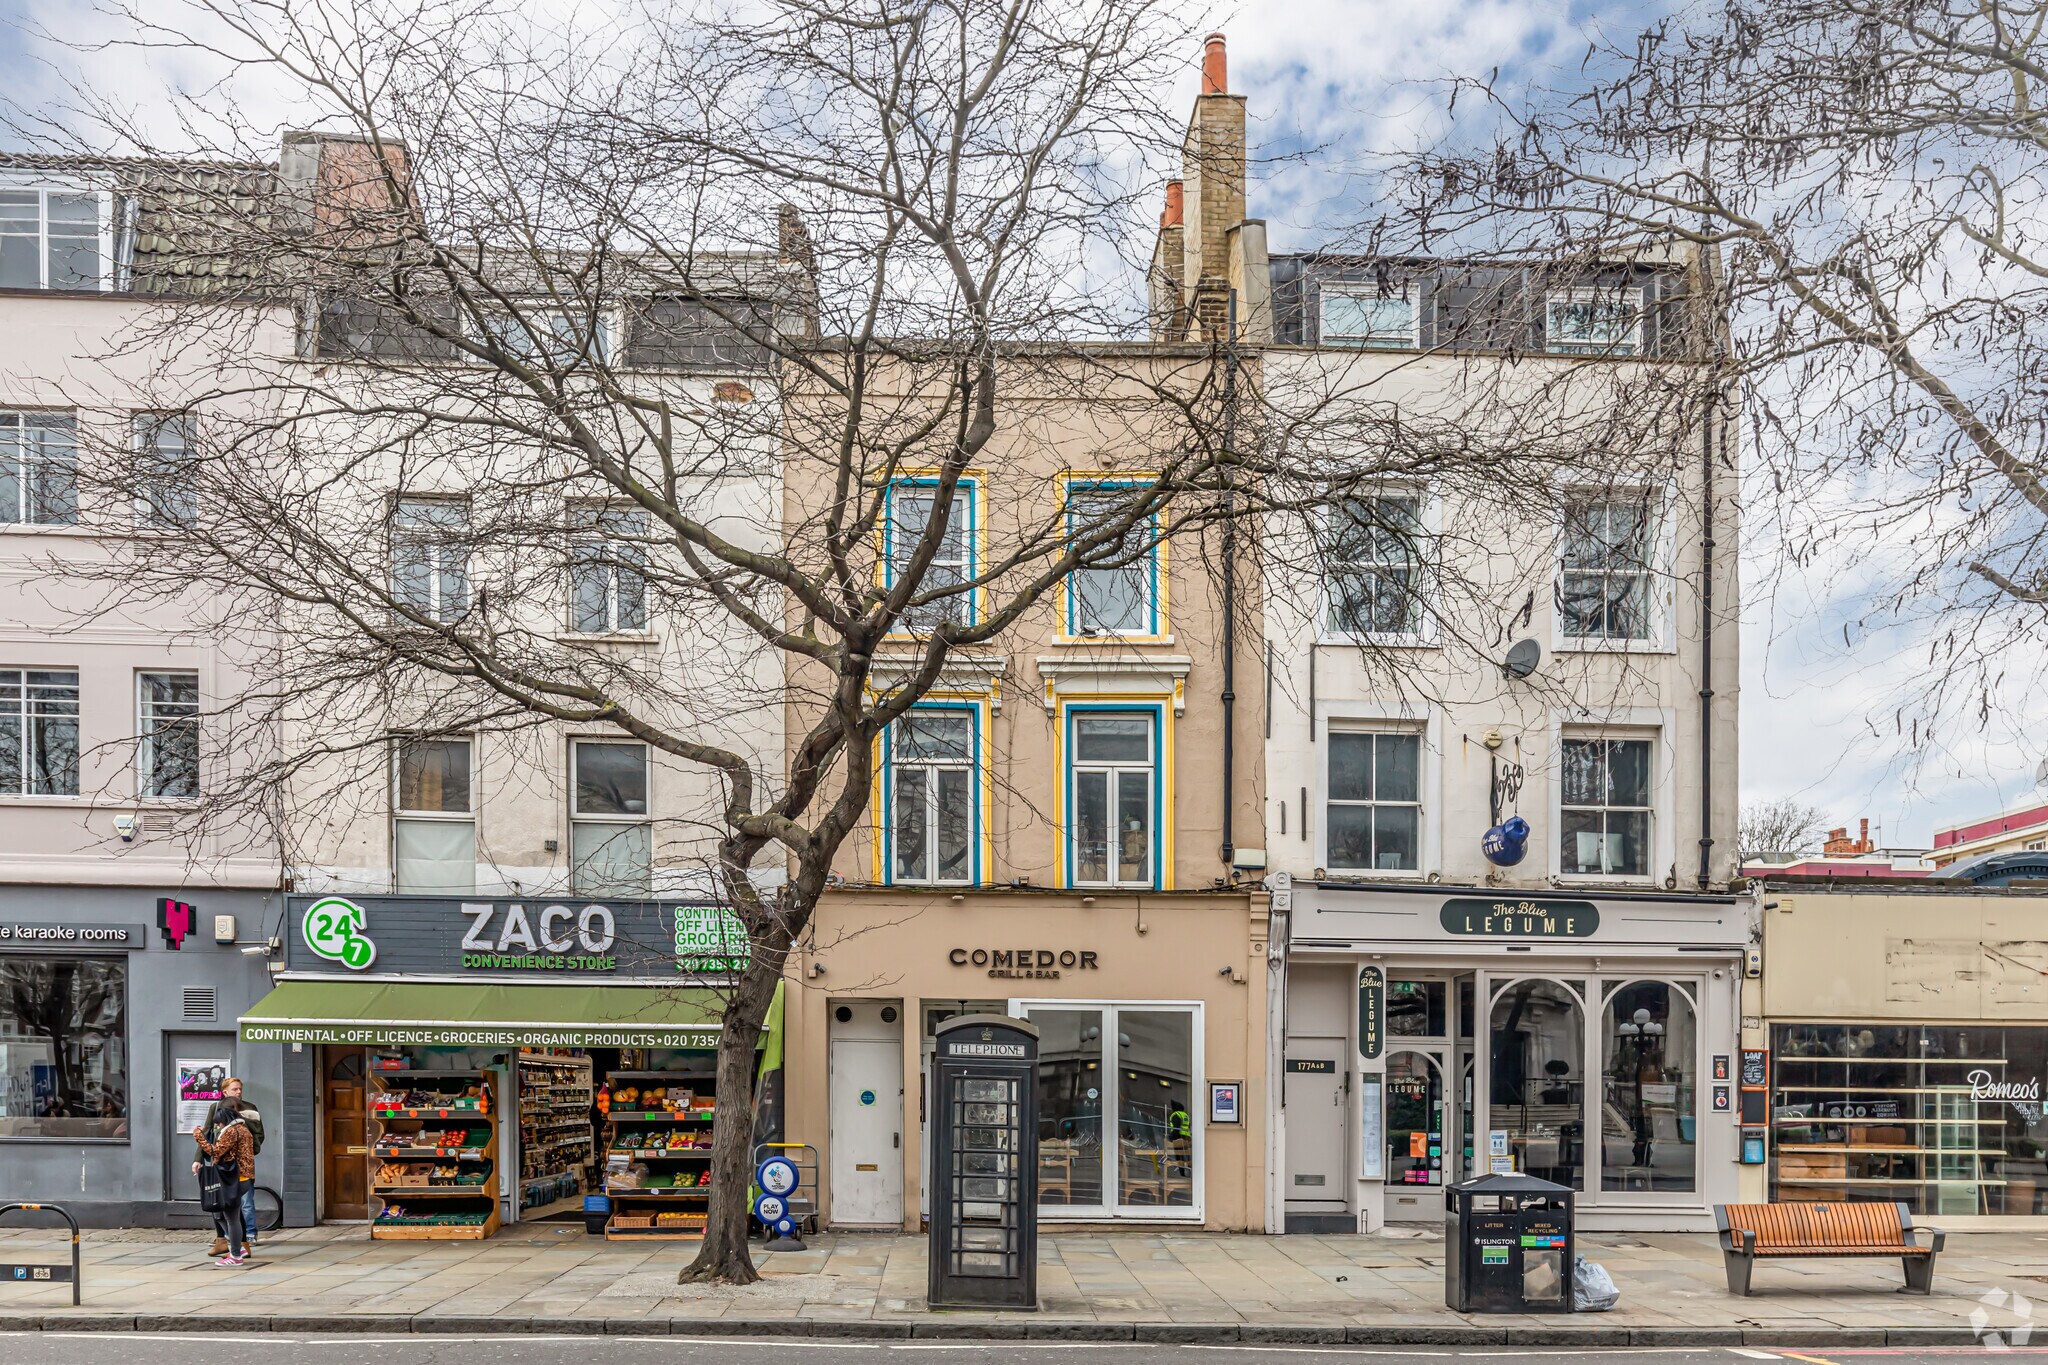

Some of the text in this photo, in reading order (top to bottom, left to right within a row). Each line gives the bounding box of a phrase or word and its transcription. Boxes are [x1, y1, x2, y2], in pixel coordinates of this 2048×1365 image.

[1493, 901, 1547, 917] The Blue
[15, 925, 75, 939] karaoke
[80, 928, 127, 940] rooms
[316, 914, 352, 941] 24
[461, 902, 616, 953] ZACO
[676, 920, 702, 932] OFF
[1465, 916, 1575, 934] LEGUME
[350, 943, 362, 962] 7
[949, 948, 1099, 970] COMEDOR
[461, 953, 616, 971] CONVENIENCE STORE
[988, 970, 1060, 979] GRILL & BAR
[1360, 977, 1382, 988] Blue
[1367, 988, 1375, 1053] LEGUME
[245, 1028, 339, 1041] CONTINENTAL
[347, 1029, 372, 1042] OFF
[376, 1030, 432, 1043] LICENCE
[441, 1031, 515, 1044] GROCERIES
[523, 1033, 582, 1045] ORGANIC
[585, 1034, 655, 1046] PRODUCTS
[664, 1035, 687, 1047] 020
[952, 1043, 1023, 1056] TELEPHONE
[1389, 1085, 1426, 1093] LEGUME
[1967, 1069, 2039, 1099] Romeo's
